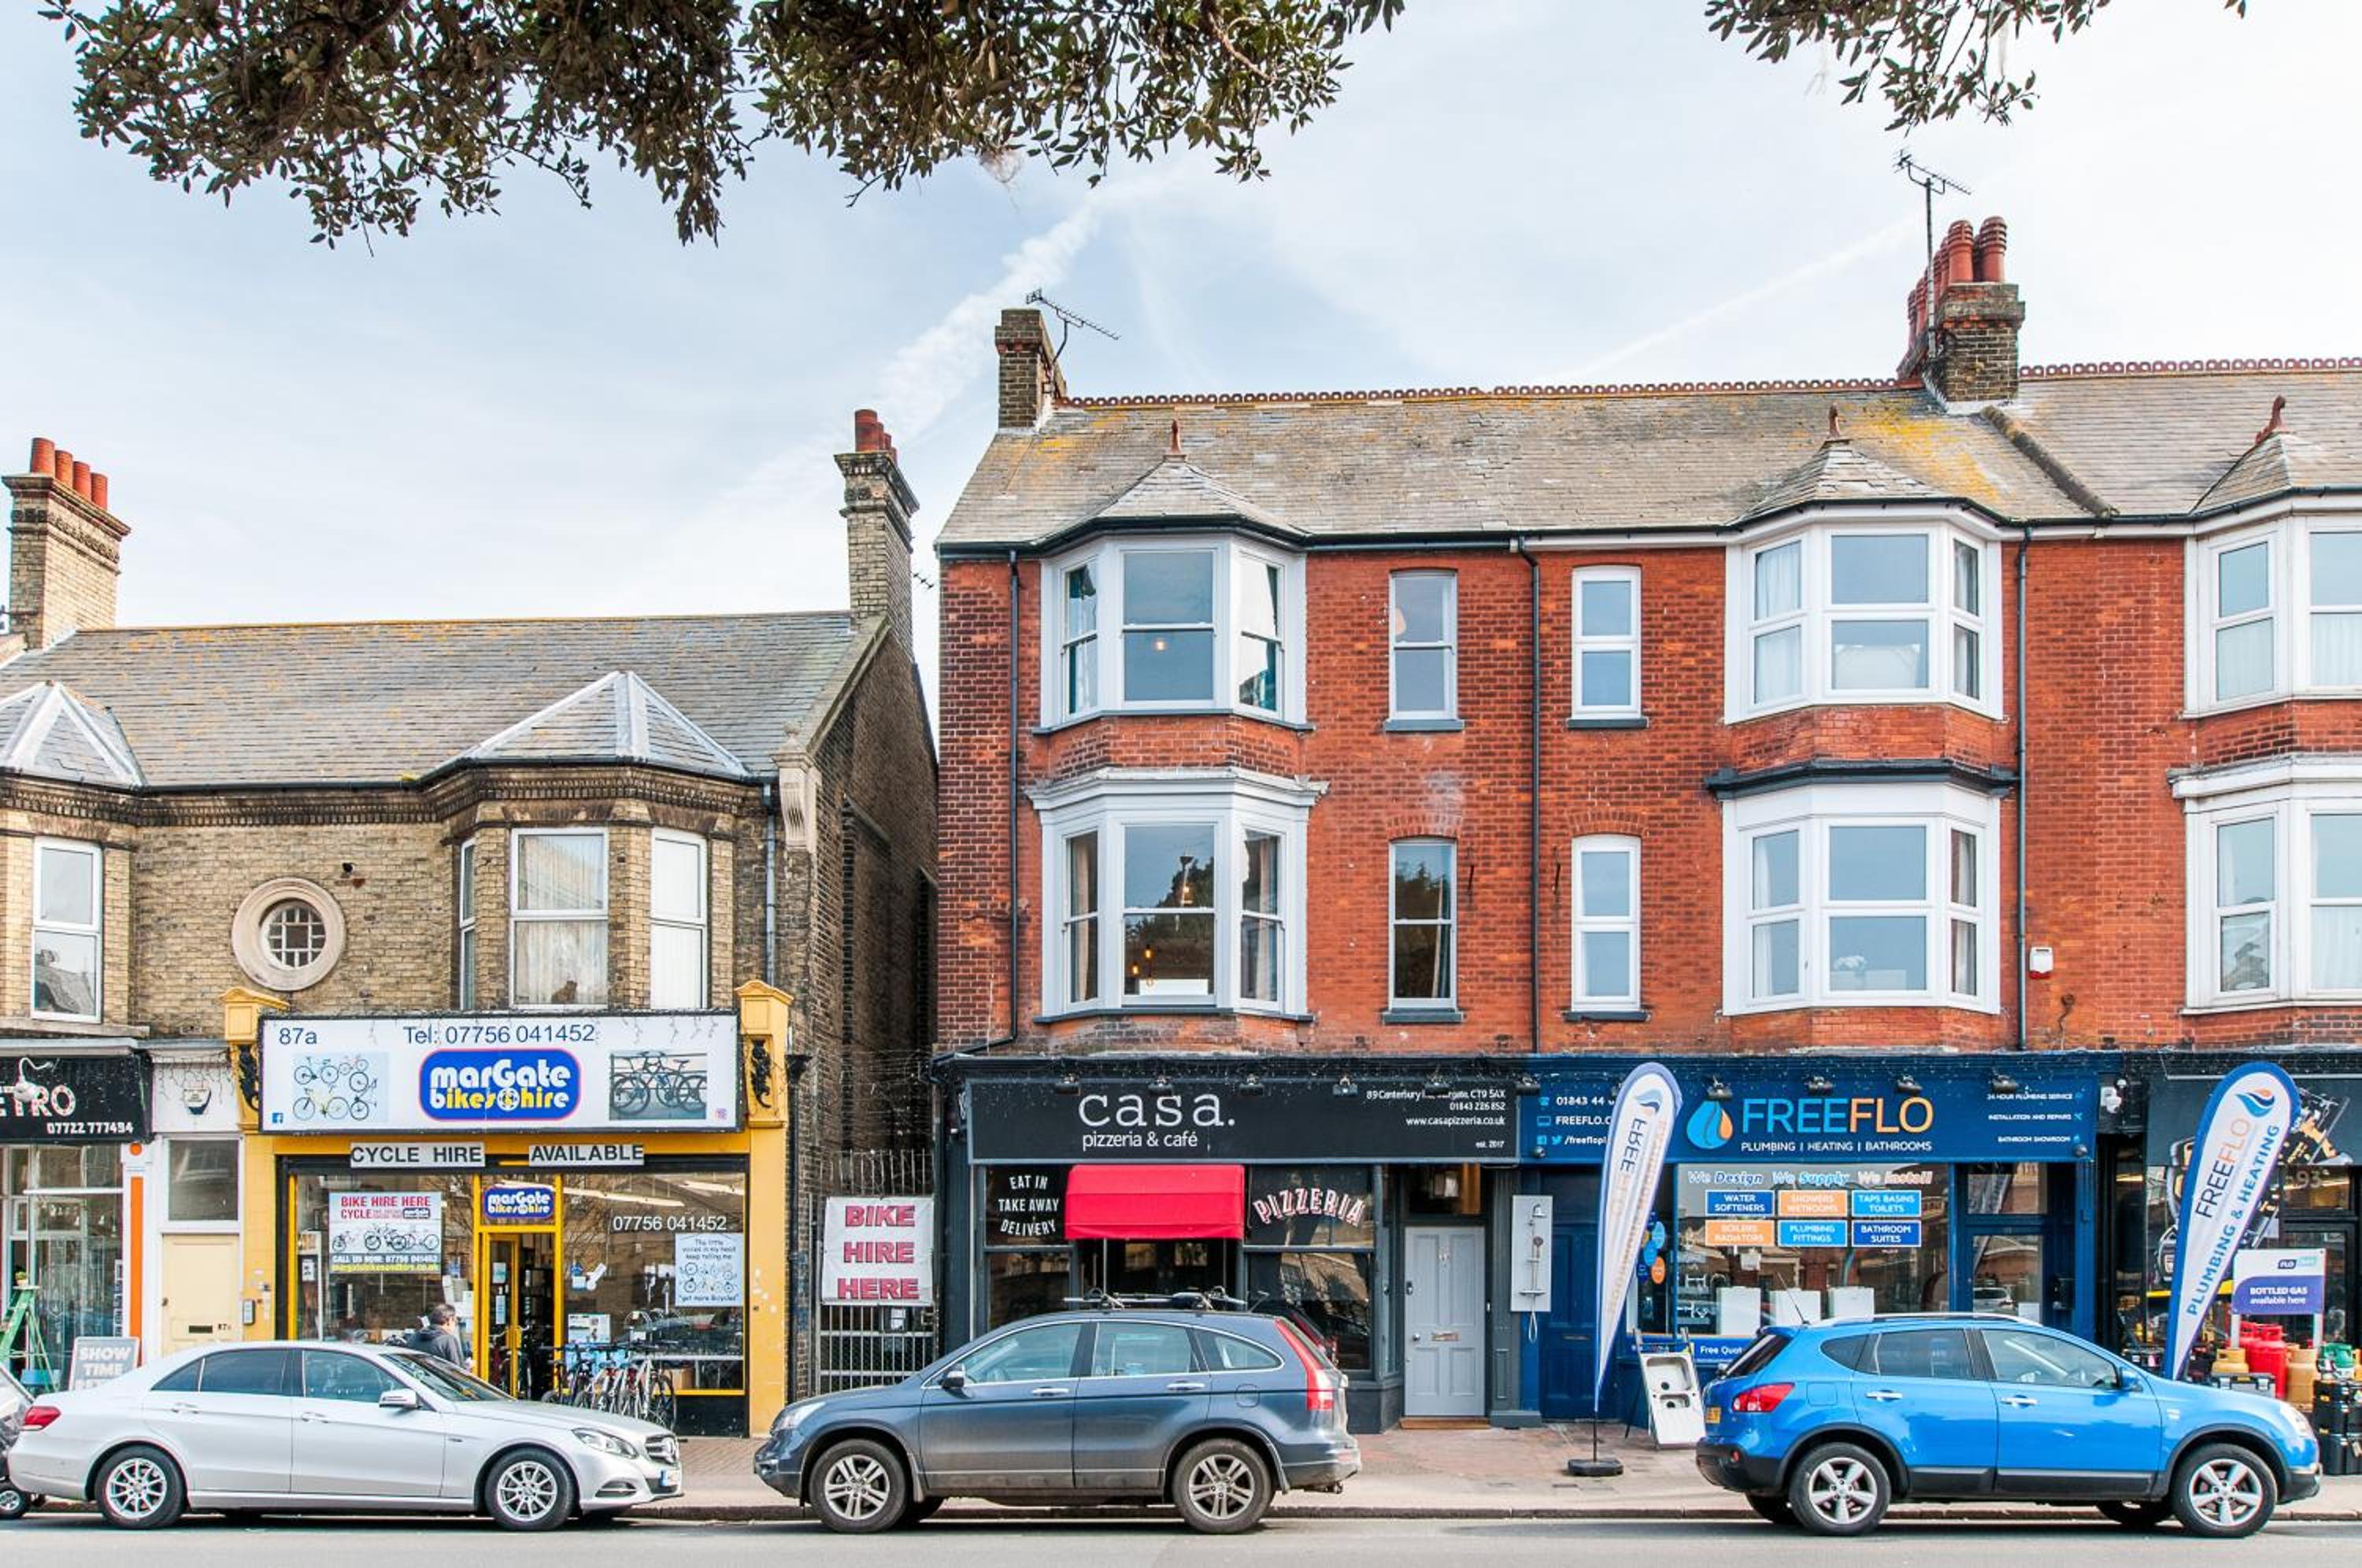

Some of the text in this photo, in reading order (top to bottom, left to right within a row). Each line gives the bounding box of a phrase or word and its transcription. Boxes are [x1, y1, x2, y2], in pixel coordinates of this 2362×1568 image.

[279, 1027, 317, 1045] 87a
[403, 1024, 594, 1044] Tel: 07756 041452
[430, 1059, 571, 1088] marGate
[1366, 1090, 1378, 1100] 89
[1470, 1089, 1487, 1099] CT9
[1079, 1094, 1235, 1126] casa.
[1742, 1096, 1934, 1133] FREEFLO
[46, 1122, 86, 1133] 07722
[1405, 1116, 1505, 1127] www.casapizzeria.co.uk
[1555, 1115, 1612, 1126] FREEFLO.C
[1083, 1130, 1198, 1151] pizzeria & café
[1742, 1141, 1933, 1152] PLUMBING HEATING BATHROOMS
[351, 1145, 644, 1163] CYCLE HIRE AVAILABLE
[2195, 1119, 2250, 1219] FREEFLO
[1009, 1175, 1048, 1190] EAT IN
[1687, 1171, 1711, 1183] We
[1714, 1170, 1764, 1185] Design
[1772, 1171, 1795, 1184] We
[1798, 1170, 1850, 1187] Supply
[1857, 1171, 1881, 1184] We
[341, 1196, 431, 1207] BIKE HIRE HERE
[998, 1198, 1059, 1212] TAKE AWAY
[1723, 1194, 1756, 1203] WATER
[1859, 1194, 1881, 1203] TAPS
[341, 1208, 372, 1219] CYCLE
[1253, 1188, 1365, 1227] PIZZERIA
[1714, 1204, 1765, 1213] SOFTENERS
[1869, 1204, 1905, 1214] TOILETS
[845, 1205, 915, 1227] BIKE
[2186, 1224, 2236, 1317] PLUMBING
[2238, 1124, 2280, 1203] HEATING
[613, 1216, 727, 1231] 07756 041452
[1000, 1219, 1056, 1236] DELIVERY
[1860, 1225, 1912, 1233] BATHROOM
[1871, 1234, 1902, 1244] SUITES
[843, 1241, 915, 1263] HIRE
[837, 1278, 919, 1300] HERE
[2249, 1286, 2308, 1295] BOTTLED GAS
[2249, 1296, 2306, 1304] available here
[80, 1347, 131, 1361] SHOW
[1720, 1346, 1742, 1355] Quot
[83, 1363, 124, 1376] TIME
